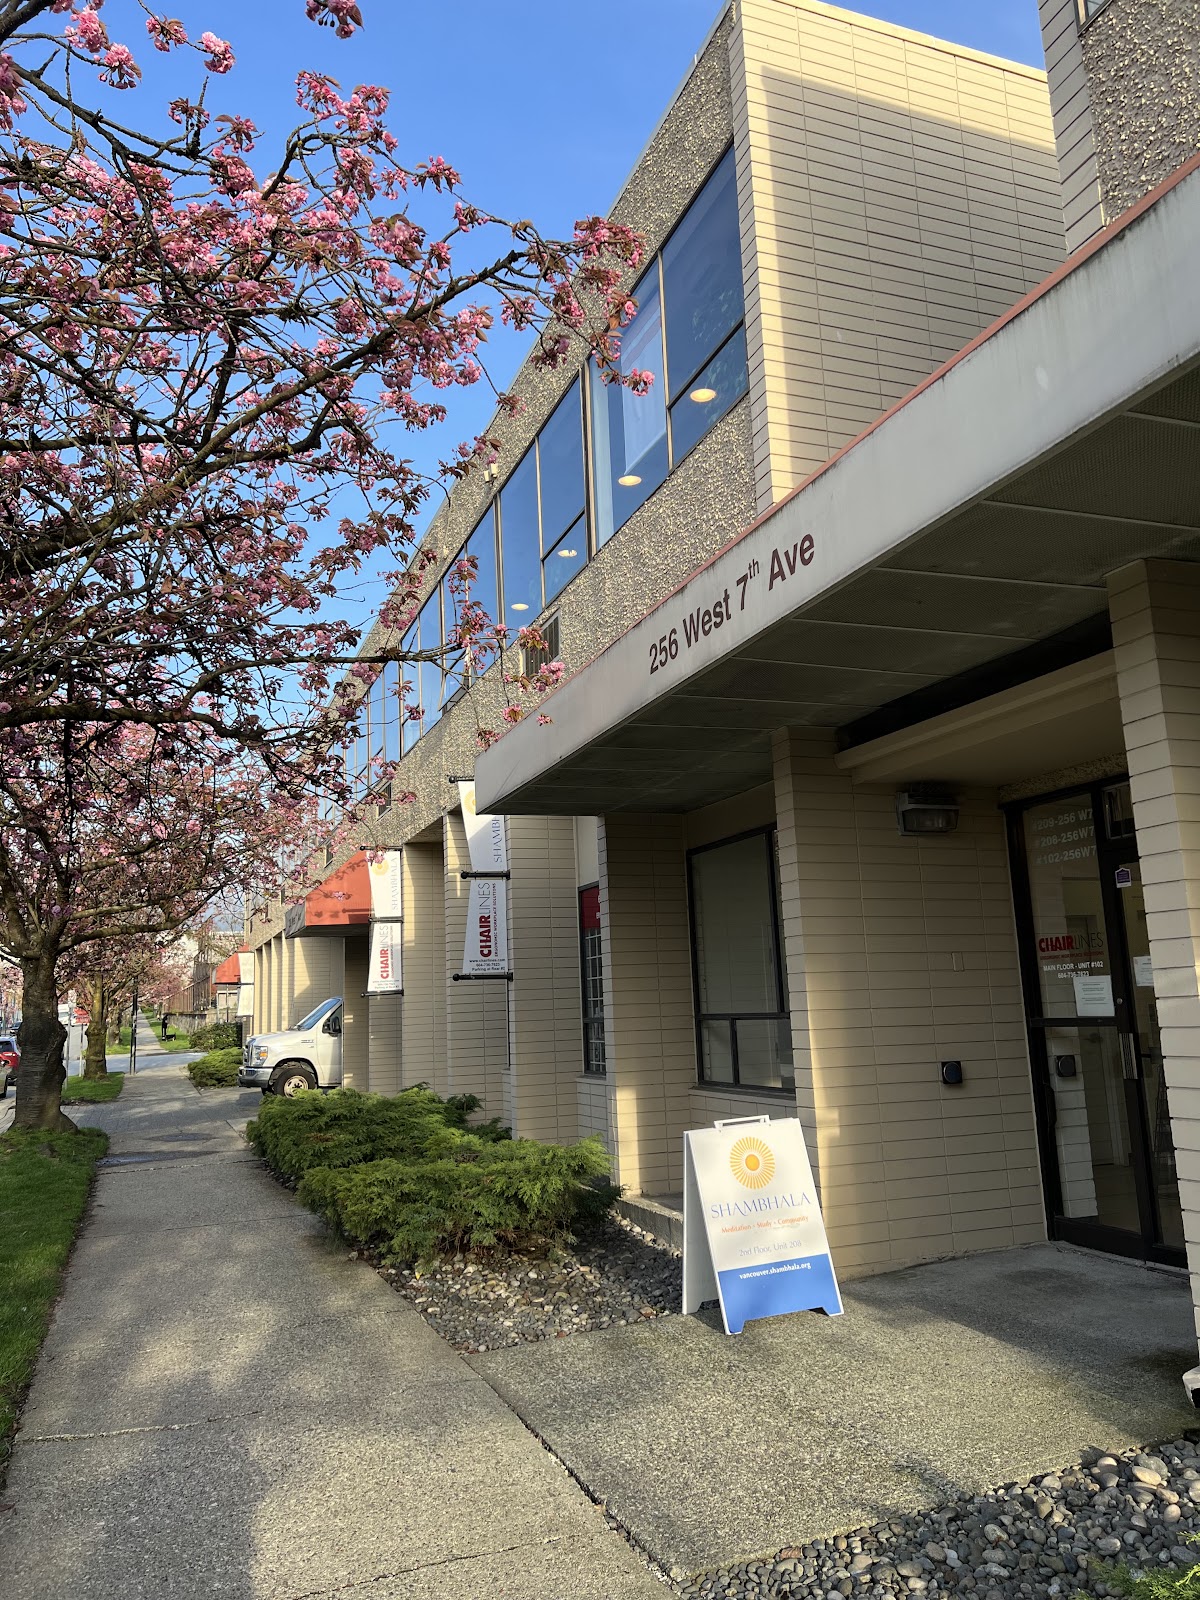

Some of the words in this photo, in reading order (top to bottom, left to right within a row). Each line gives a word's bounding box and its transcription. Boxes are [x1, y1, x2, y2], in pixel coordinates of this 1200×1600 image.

[649, 628, 678, 675] 256
[683, 589, 731, 648] West
[736, 559, 760, 611] 7th
[769, 534, 815, 592] Ave
[477, 882, 492, 958] CHAIRLINES
[379, 925, 389, 979] CHAIRLINES
[1039, 932, 1104, 953] CHAIRLINES
[711, 1191, 811, 1219] SHAMBHALA
[721, 1224, 752, 1234] Meditation
[756, 1220, 772, 1230] Study
[777, 1215, 809, 1225] Community
[739, 1248, 752, 1257] 2nd
[754, 1244, 772, 1254] Floor,
[773, 1242, 788, 1251] Unit
[789, 1240, 802, 1249] 208
[739, 1262, 812, 1279] vancouver.shambhala.org
